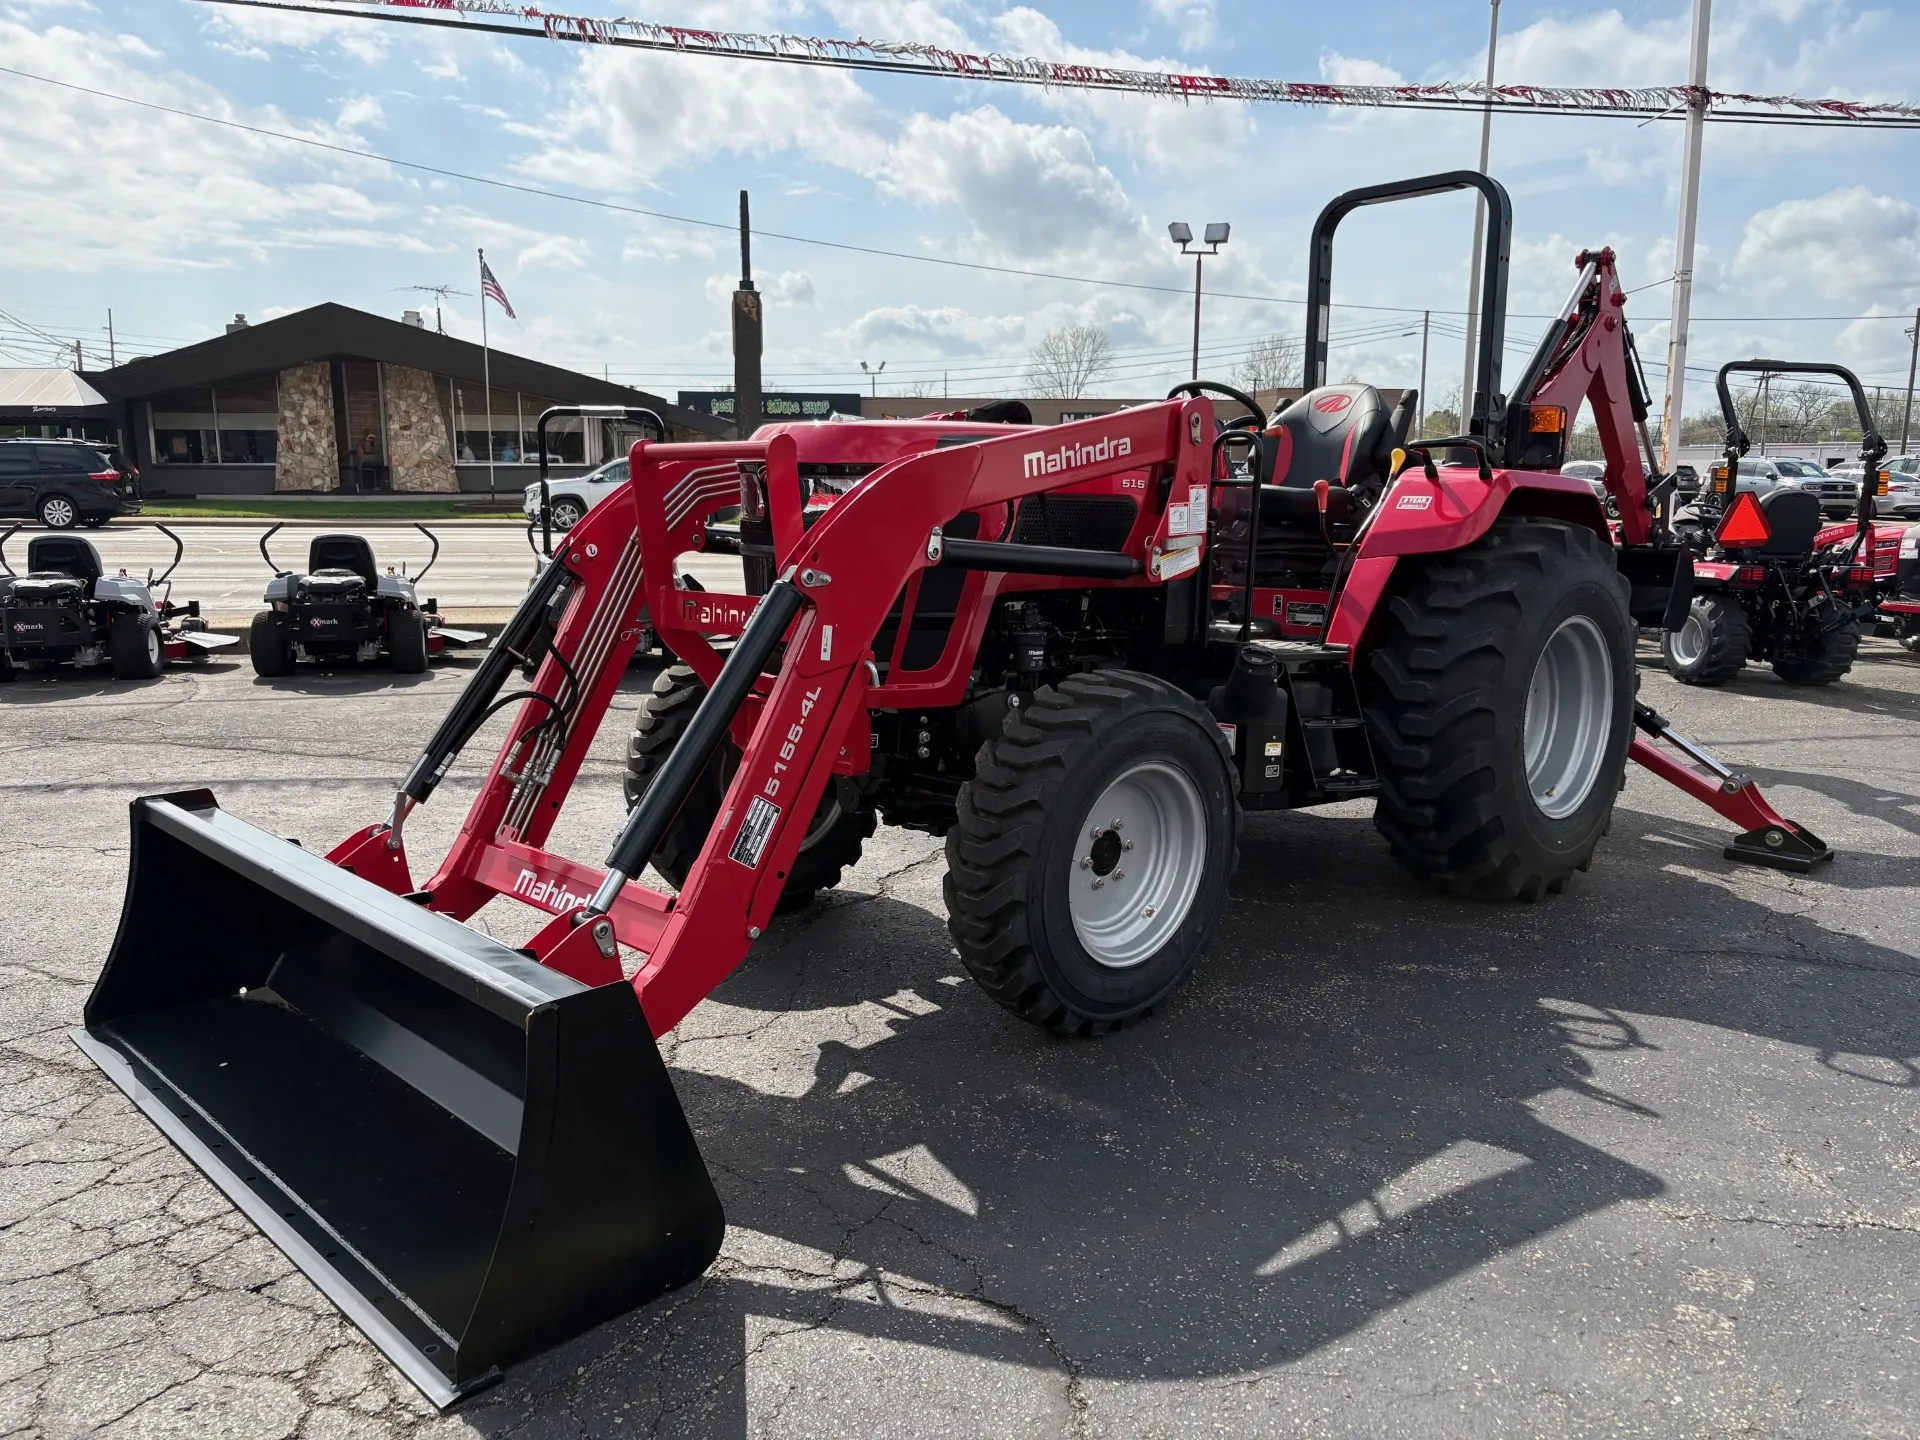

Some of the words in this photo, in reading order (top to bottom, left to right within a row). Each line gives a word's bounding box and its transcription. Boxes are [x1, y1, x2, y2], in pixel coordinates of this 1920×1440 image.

[802, 400, 829, 414] SHOP
[1023, 436, 1131, 478] Mahindra
[764, 687, 821, 797] 5155-4L
